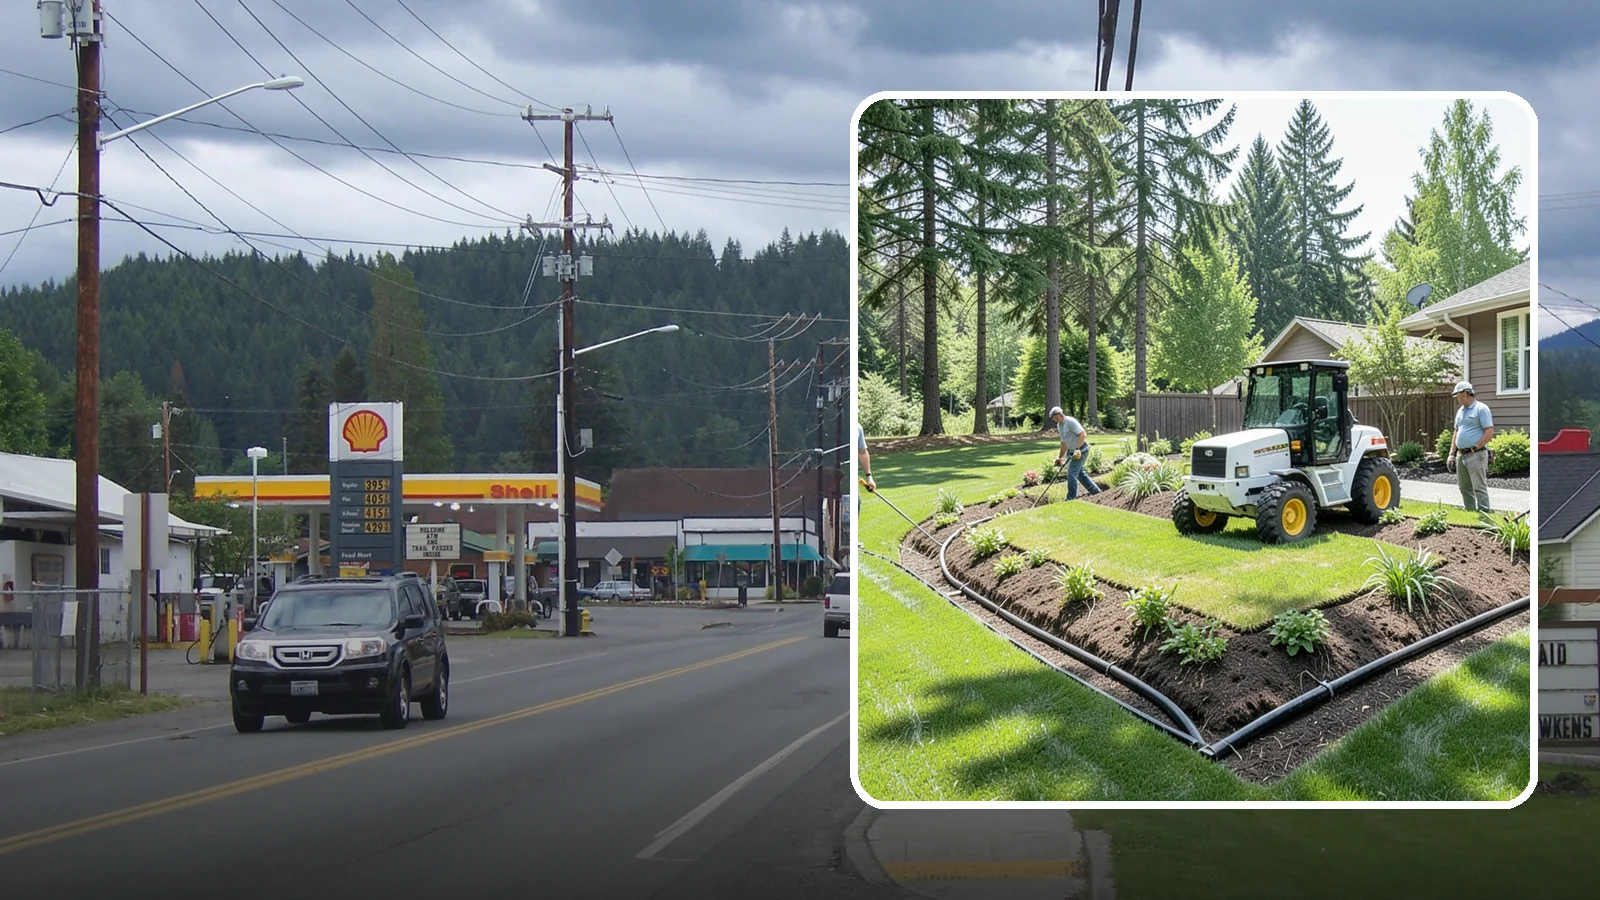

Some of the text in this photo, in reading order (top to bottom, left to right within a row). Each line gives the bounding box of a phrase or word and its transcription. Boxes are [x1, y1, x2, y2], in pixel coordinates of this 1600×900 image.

[366, 480, 383, 490] 395
[490, 484, 547, 498] Shell
[366, 494, 383, 504] 405
[366, 508, 383, 518] 415
[366, 522, 383, 532] 429
[1538, 643, 1566, 665] AID
